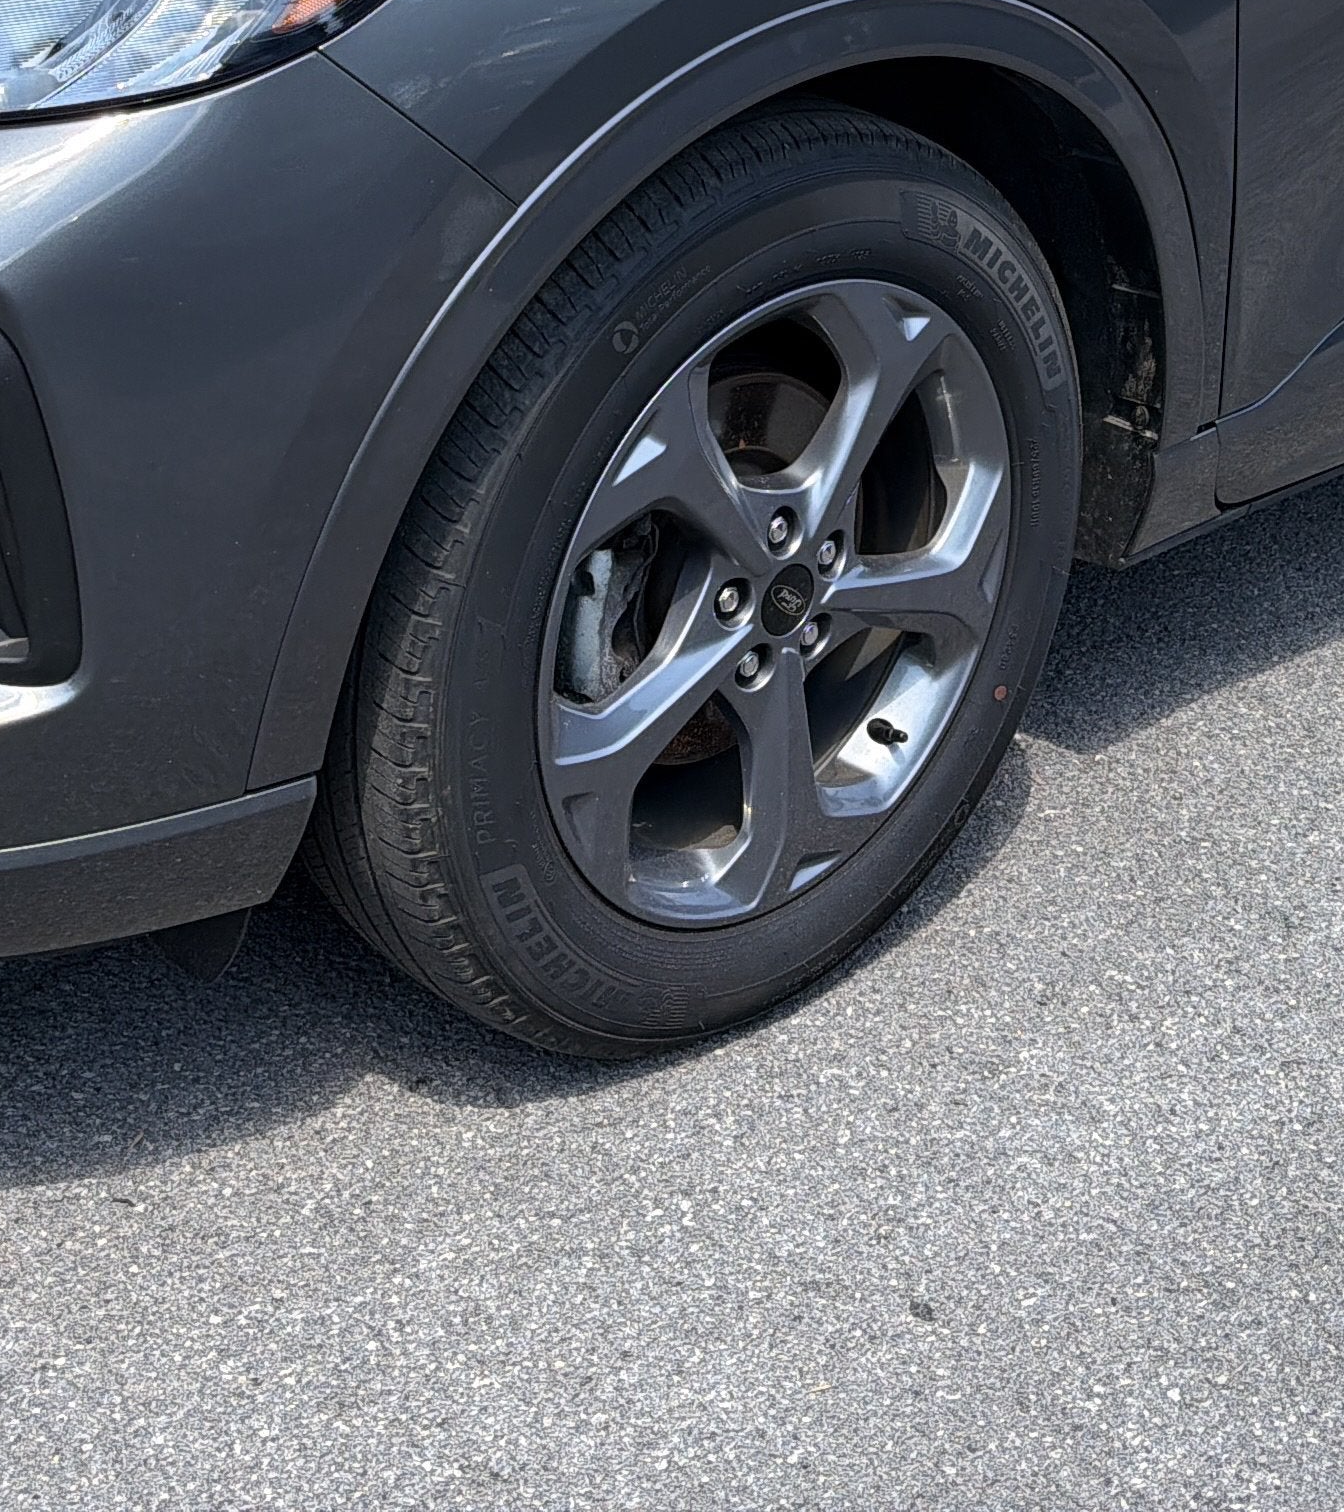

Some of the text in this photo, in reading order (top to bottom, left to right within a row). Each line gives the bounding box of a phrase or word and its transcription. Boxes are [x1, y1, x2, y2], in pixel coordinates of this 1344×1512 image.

[635, 265, 688, 320] MICHELIN
[963, 226, 1062, 380] MICHELIN
[776, 588, 802, 612] Ford
[469, 710, 498, 846] PRIMACY
[491, 875, 631, 1009] MICHELIN
